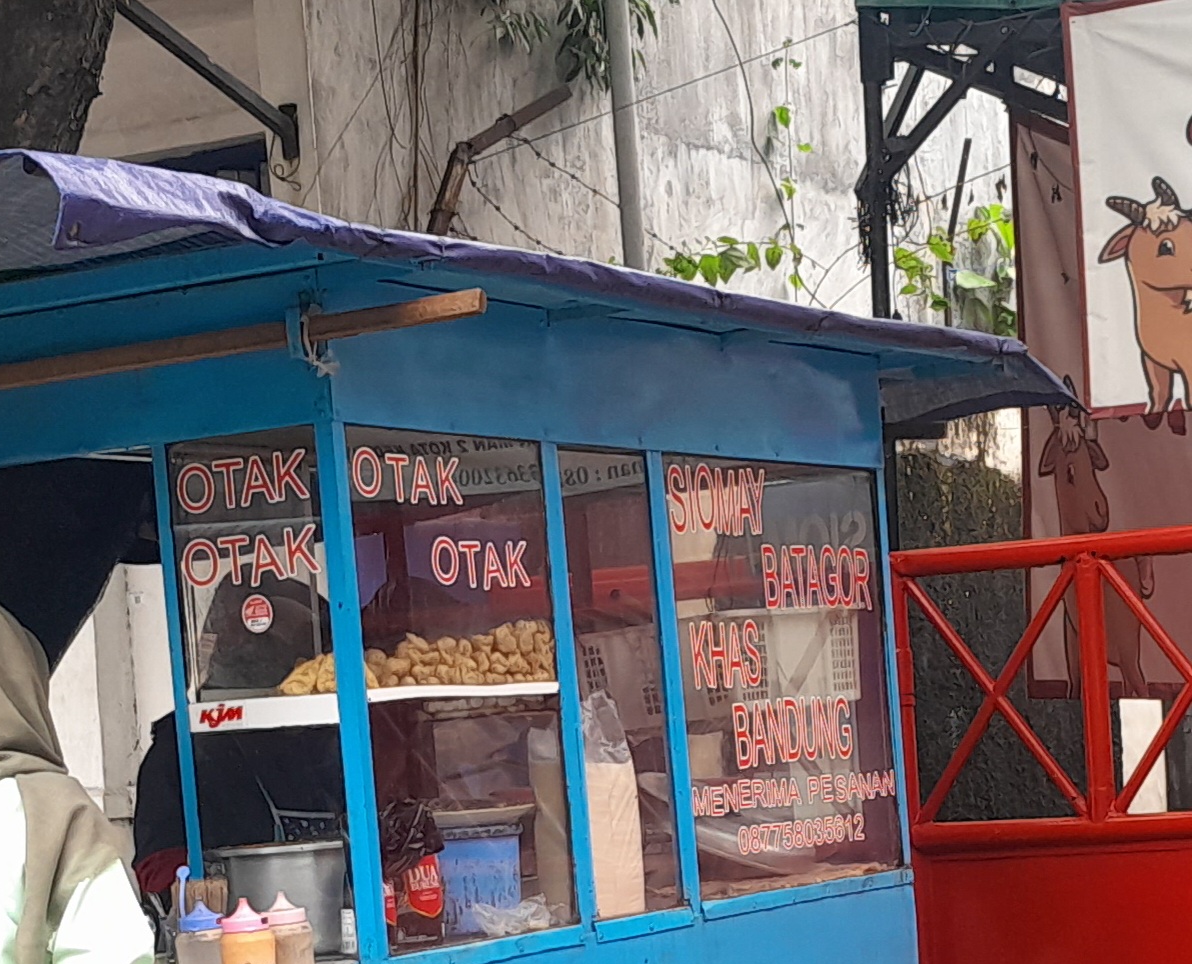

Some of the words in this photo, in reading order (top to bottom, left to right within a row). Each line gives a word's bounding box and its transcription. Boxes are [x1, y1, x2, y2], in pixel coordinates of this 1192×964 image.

[177, 449, 310, 514] OTAK
[352, 447, 464, 505] OTAK
[667, 463, 765, 536] SIOMAY
[182, 523, 321, 588] OTAK
[431, 536, 531, 591] OTAK
[761, 544, 873, 610] BATAGOR
[689, 619, 761, 690] KHAS
[732, 695, 852, 769] BANDUNG
[692, 778, 802, 817] MENERIMA
[808, 769, 895, 804] PESANAN
[408, 864, 439, 883] DUA
